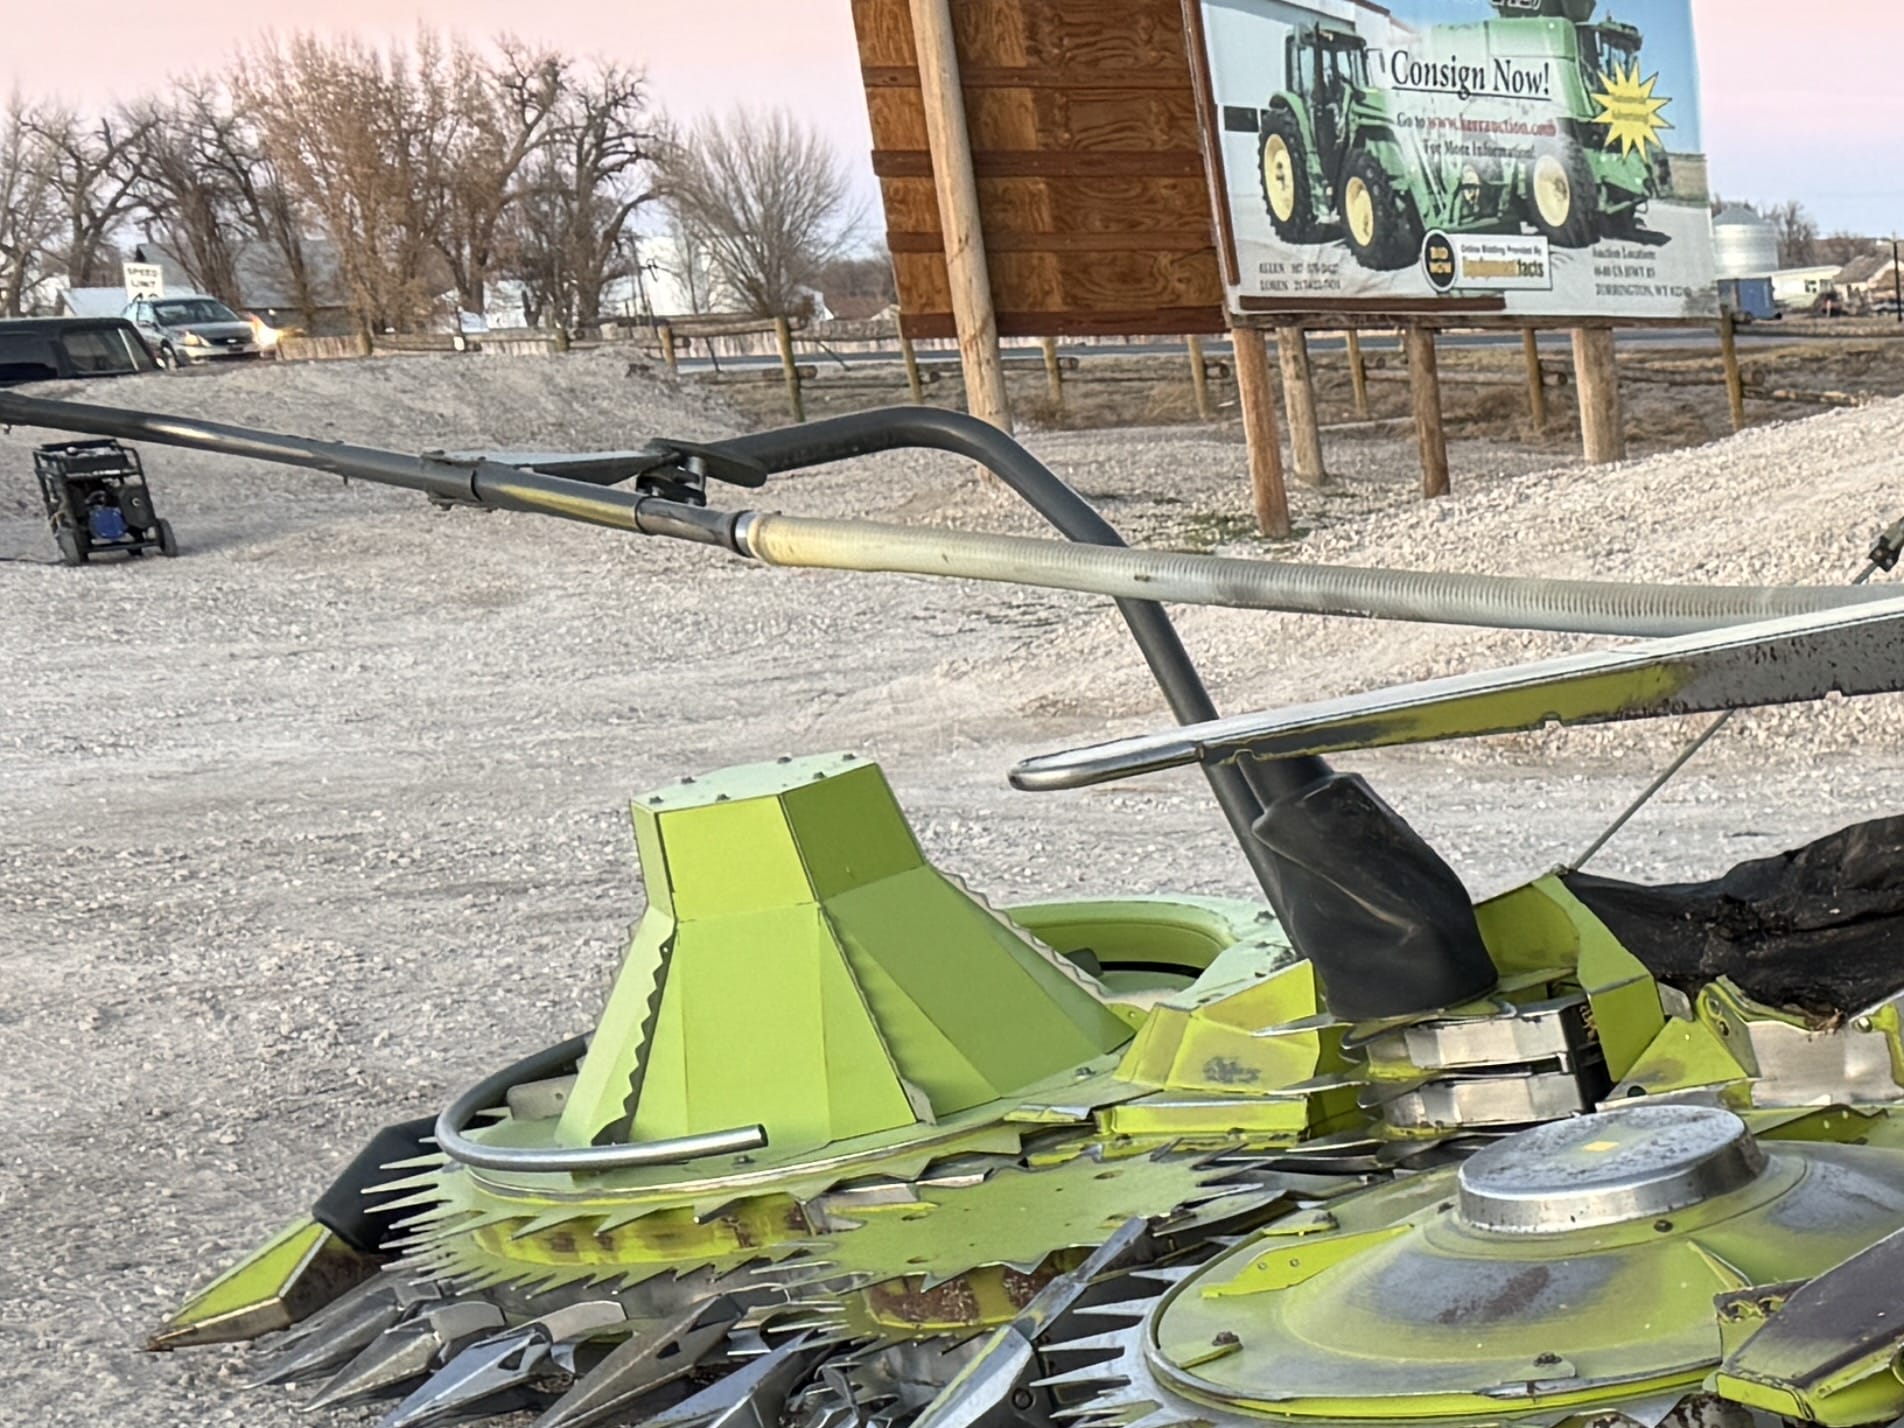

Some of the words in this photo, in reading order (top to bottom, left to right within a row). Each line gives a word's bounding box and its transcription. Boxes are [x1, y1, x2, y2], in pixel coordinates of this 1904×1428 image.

[1391, 50, 1485, 100] Consign
[1494, 58, 1549, 95] Now!
[1397, 112, 1413, 128] Go
[1415, 115, 1426, 128] to
